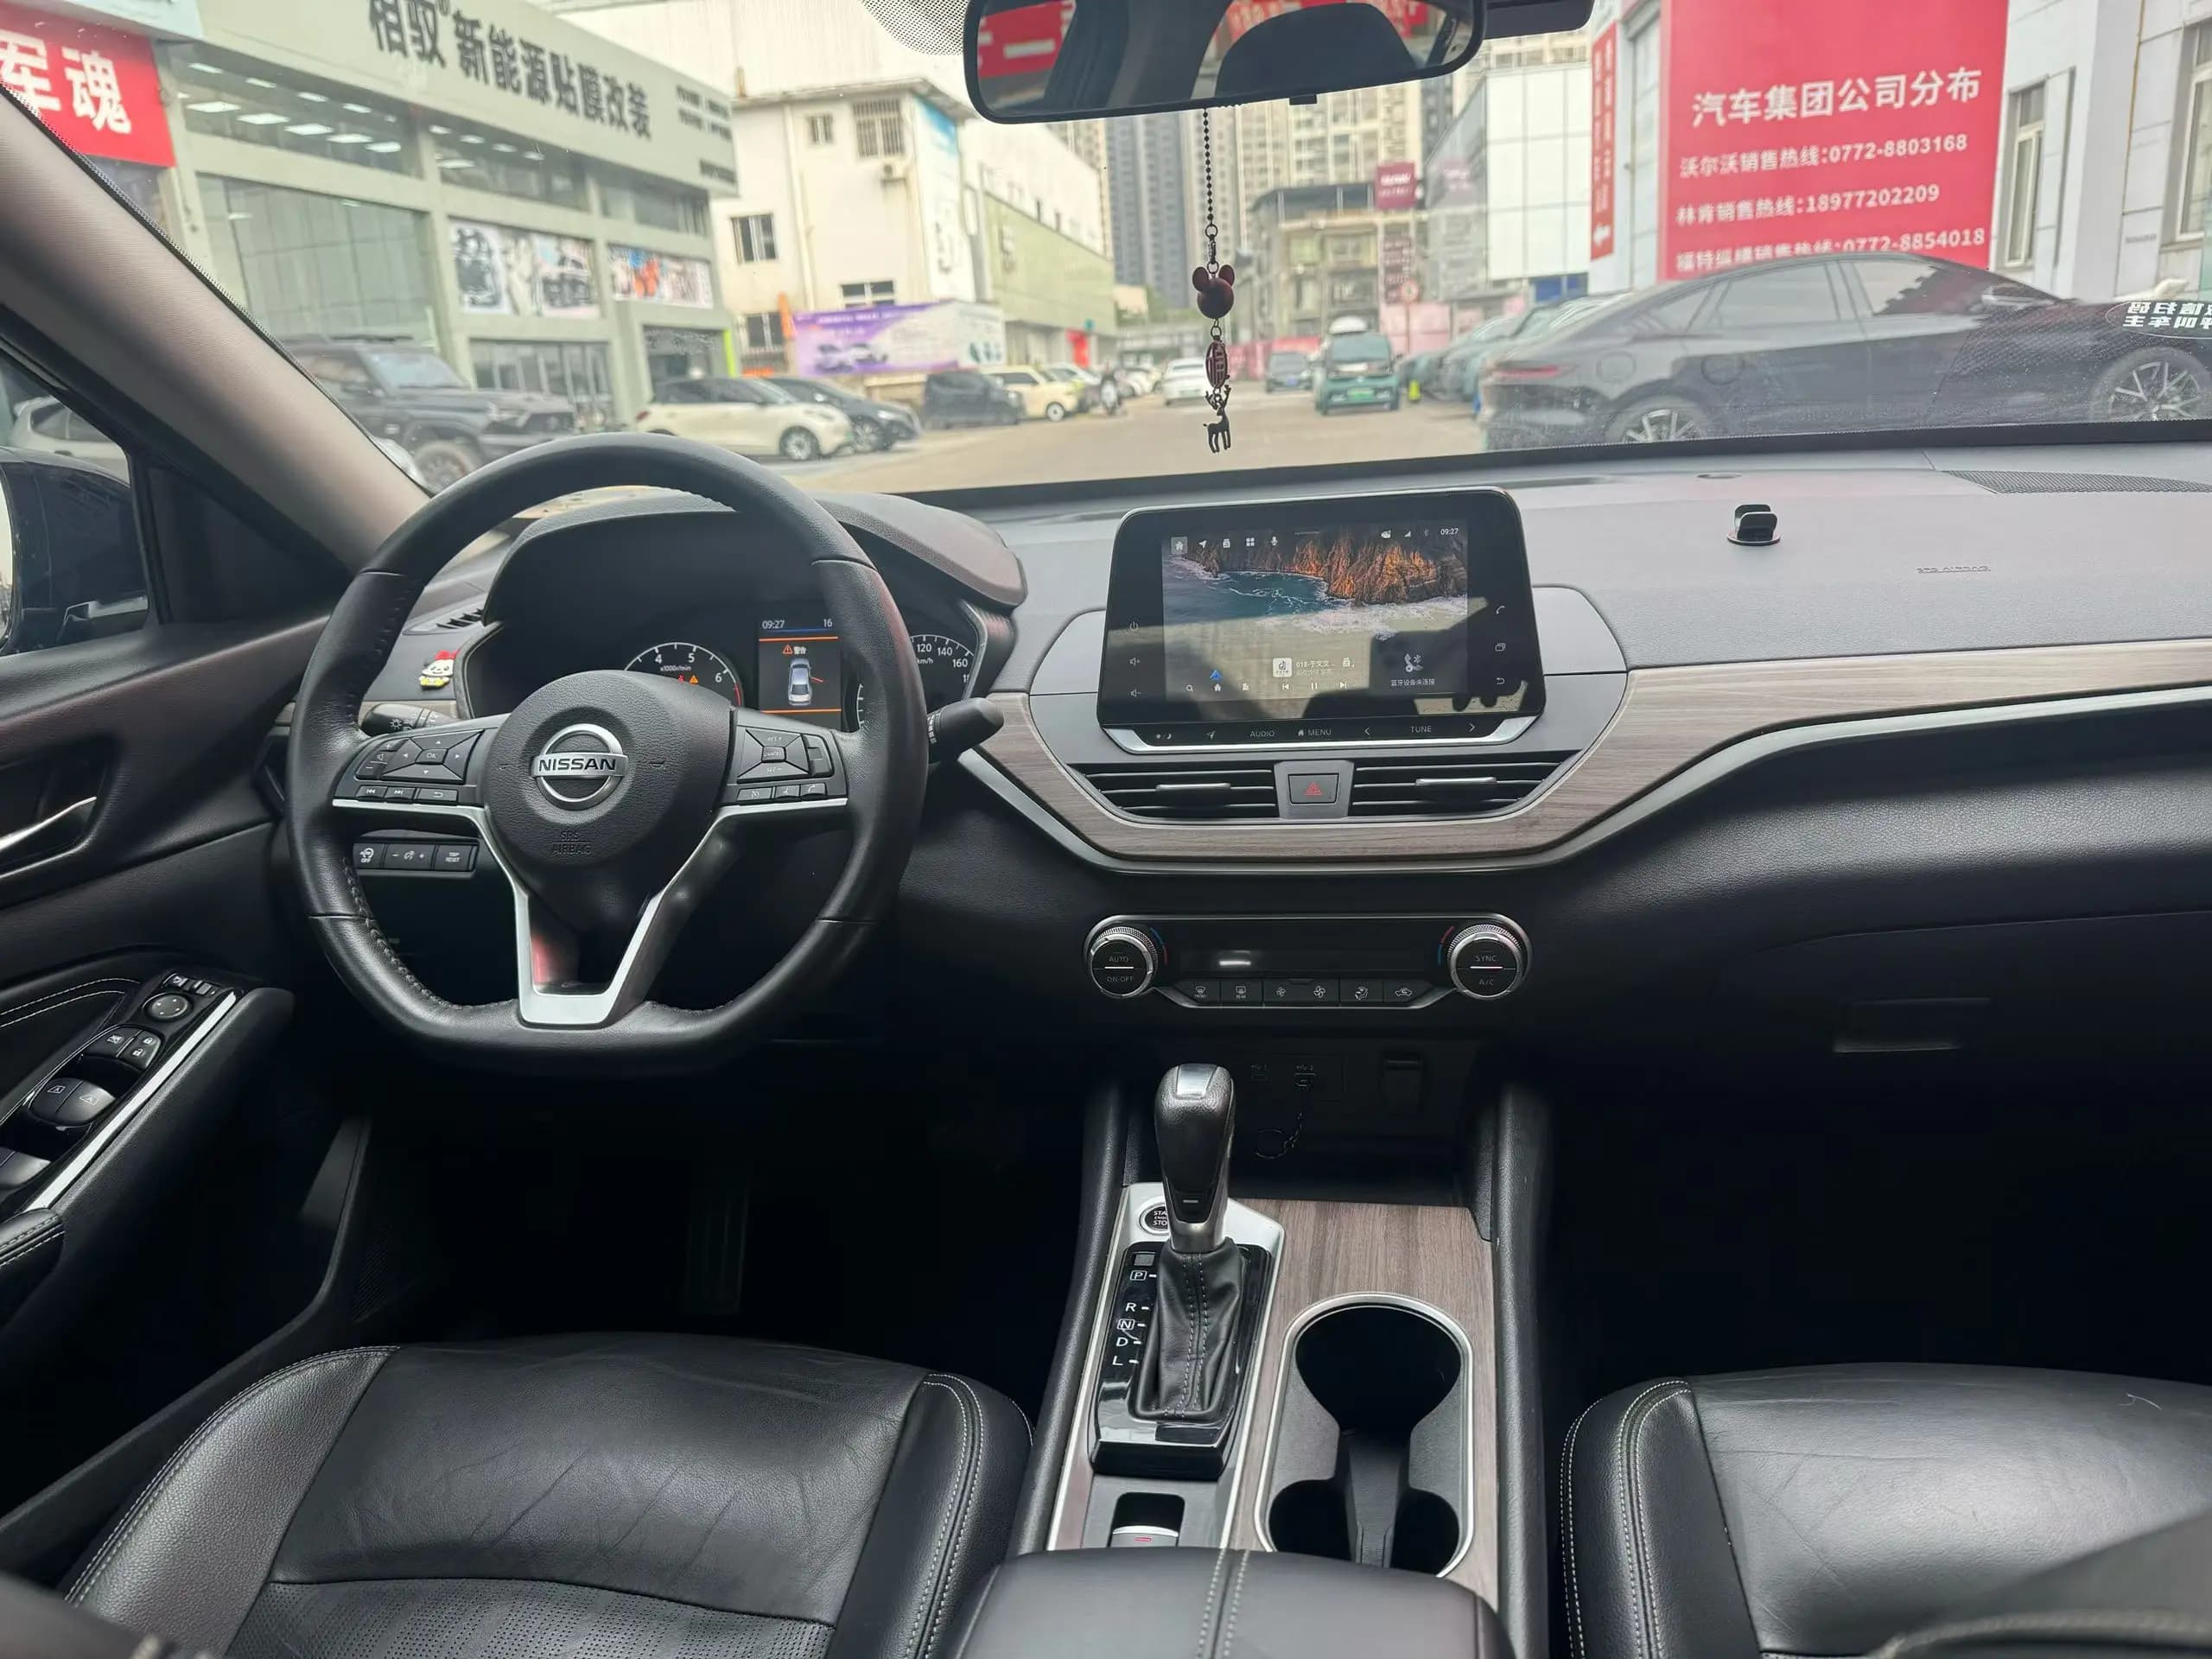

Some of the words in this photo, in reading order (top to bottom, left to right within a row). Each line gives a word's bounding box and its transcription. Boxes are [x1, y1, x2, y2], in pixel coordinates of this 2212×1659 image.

[1691, 67, 1982, 128] 汽车集团公司分布
[761, 620, 785, 630] 09:27
[823, 618, 833, 627] 16
[917, 643, 932, 652] 120
[938, 646, 953, 656] 140
[654, 653, 663, 664] 4
[688, 652, 696, 664] 5
[952, 658, 969, 668] 160
[715, 672, 722, 683] 6
[1249, 729, 1275, 738] AUDIO
[1410, 725, 1432, 734] TUNE
[538, 758, 616, 772] NISSAN
[1135, 1271, 1144, 1280] P
[1125, 1302, 1137, 1312] R
[1120, 1319, 1131, 1329] N
[1116, 1337, 1128, 1347] D
[1112, 1355, 1123, 1365] L
